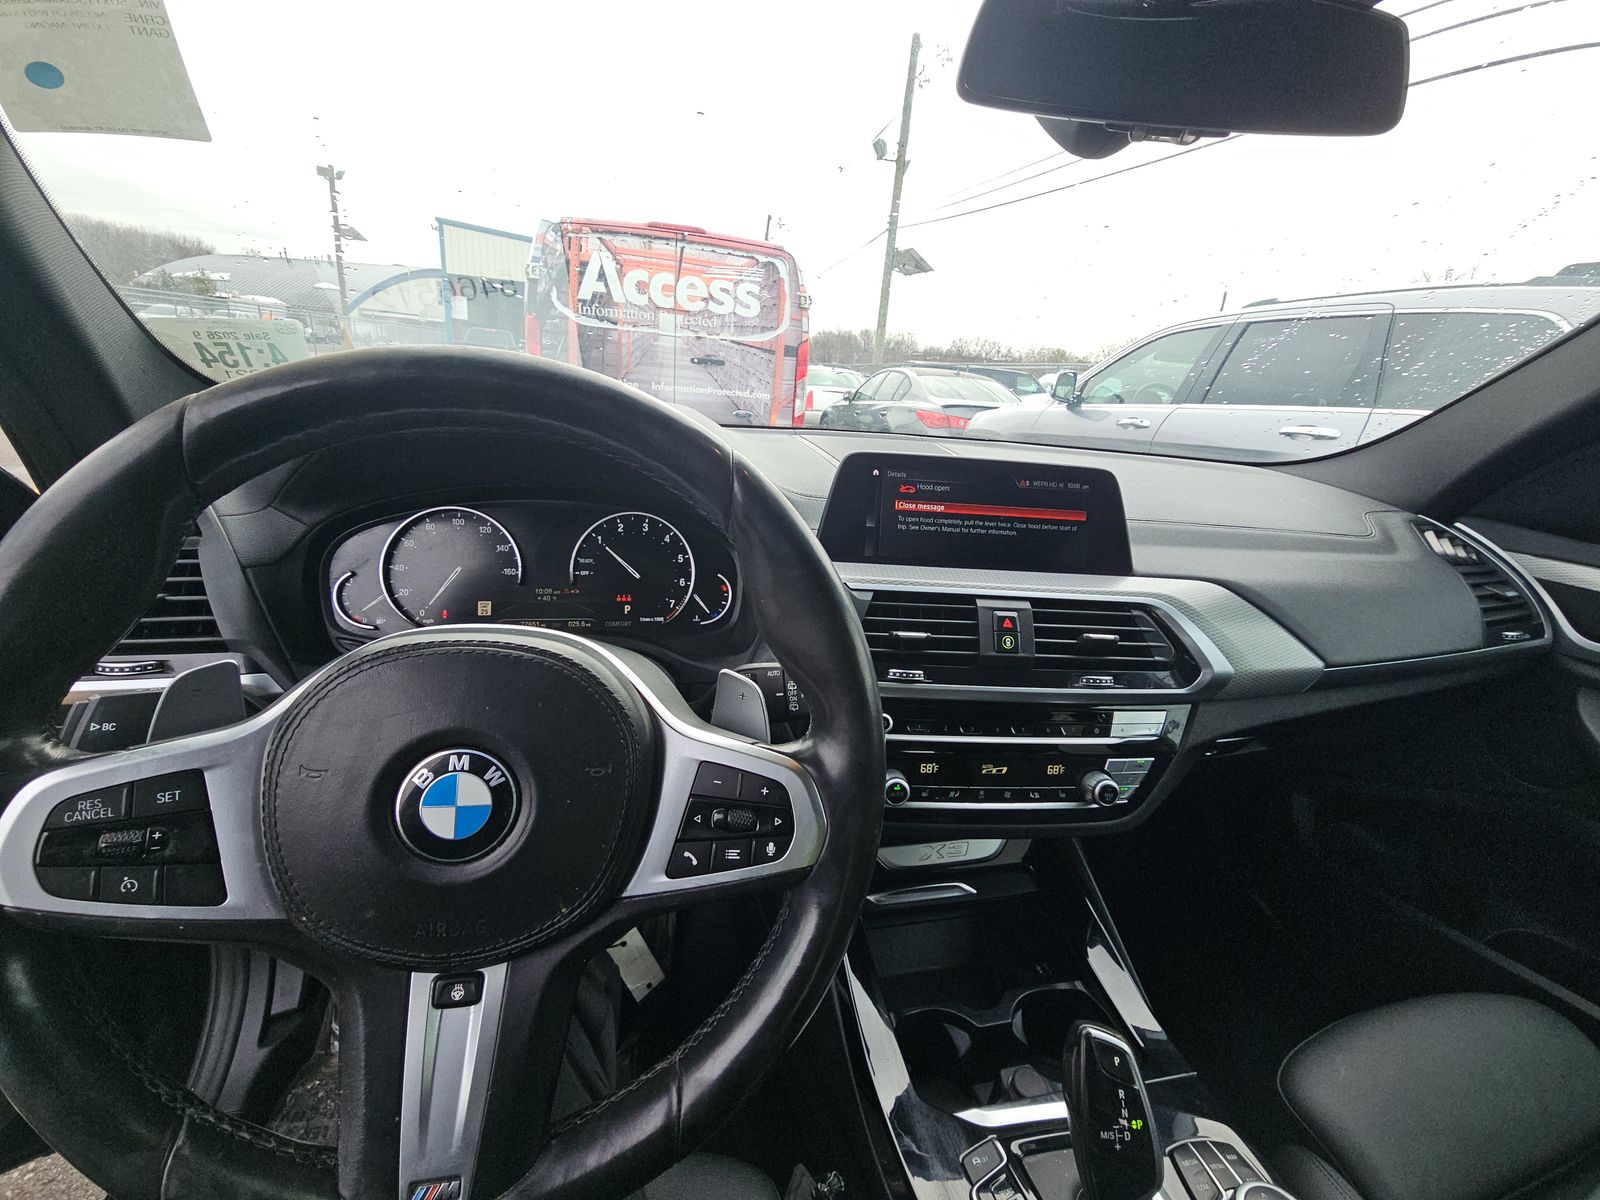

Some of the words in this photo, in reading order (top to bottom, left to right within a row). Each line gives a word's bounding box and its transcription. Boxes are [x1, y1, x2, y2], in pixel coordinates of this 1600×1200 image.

[578, 246, 761, 318] Access
[578, 302, 655, 320] Information
[651, 382, 770, 400] InformationProtected.com
[918, 504, 945, 512] message
[618, 524, 624, 532] 2
[642, 523, 648, 532] 3
[597, 536, 602, 544] 1
[664, 534, 670, 543] 4
[678, 554, 684, 562] 5
[680, 578, 686, 586] 6
[670, 600, 676, 608] 7
[624, 605, 631, 614] P
[102, 722, 117, 731] BC
[411, 754, 506, 790] BMW
[156, 790, 182, 804] SET
[78, 798, 102, 810] RES
[64, 807, 116, 823] CANCEL
[920, 841, 970, 862] X3
[414, 919, 487, 938] AIRBAG
[1114, 1056, 1120, 1066] P
[1118, 1088, 1126, 1100] R
[1122, 1108, 1129, 1118] N
[1136, 1120, 1143, 1130] P
[1100, 1131, 1115, 1140] M/S
[1124, 1131, 1131, 1140] D
[1182, 1158, 1198, 1167] MEDIA
